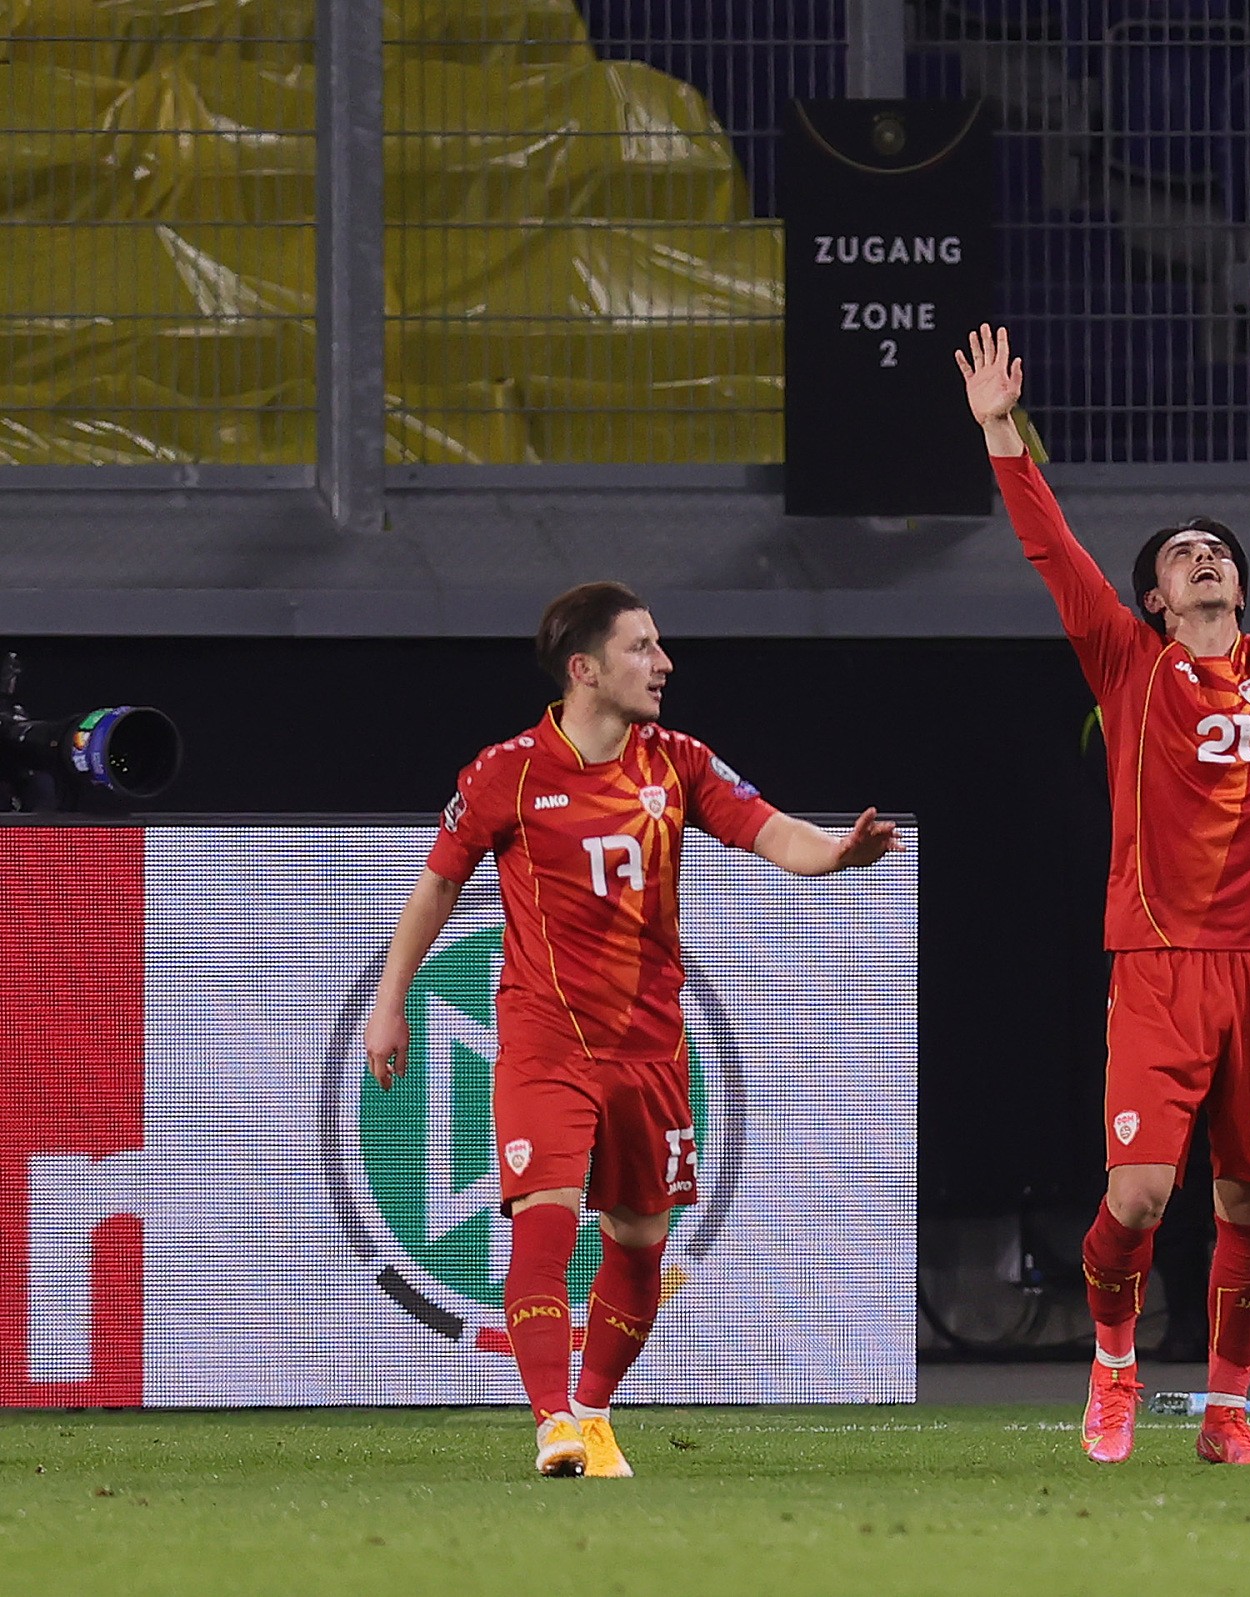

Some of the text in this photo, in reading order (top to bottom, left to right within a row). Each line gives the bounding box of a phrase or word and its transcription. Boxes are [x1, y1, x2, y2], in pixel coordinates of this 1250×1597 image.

[814, 236, 962, 264] ZUGANG
[840, 302, 936, 331] ZONE
[879, 339, 899, 368] 2
[534, 794, 570, 810] JAKO
[582, 833, 646, 897] 17
[512, 1305, 562, 1328] JAKO
